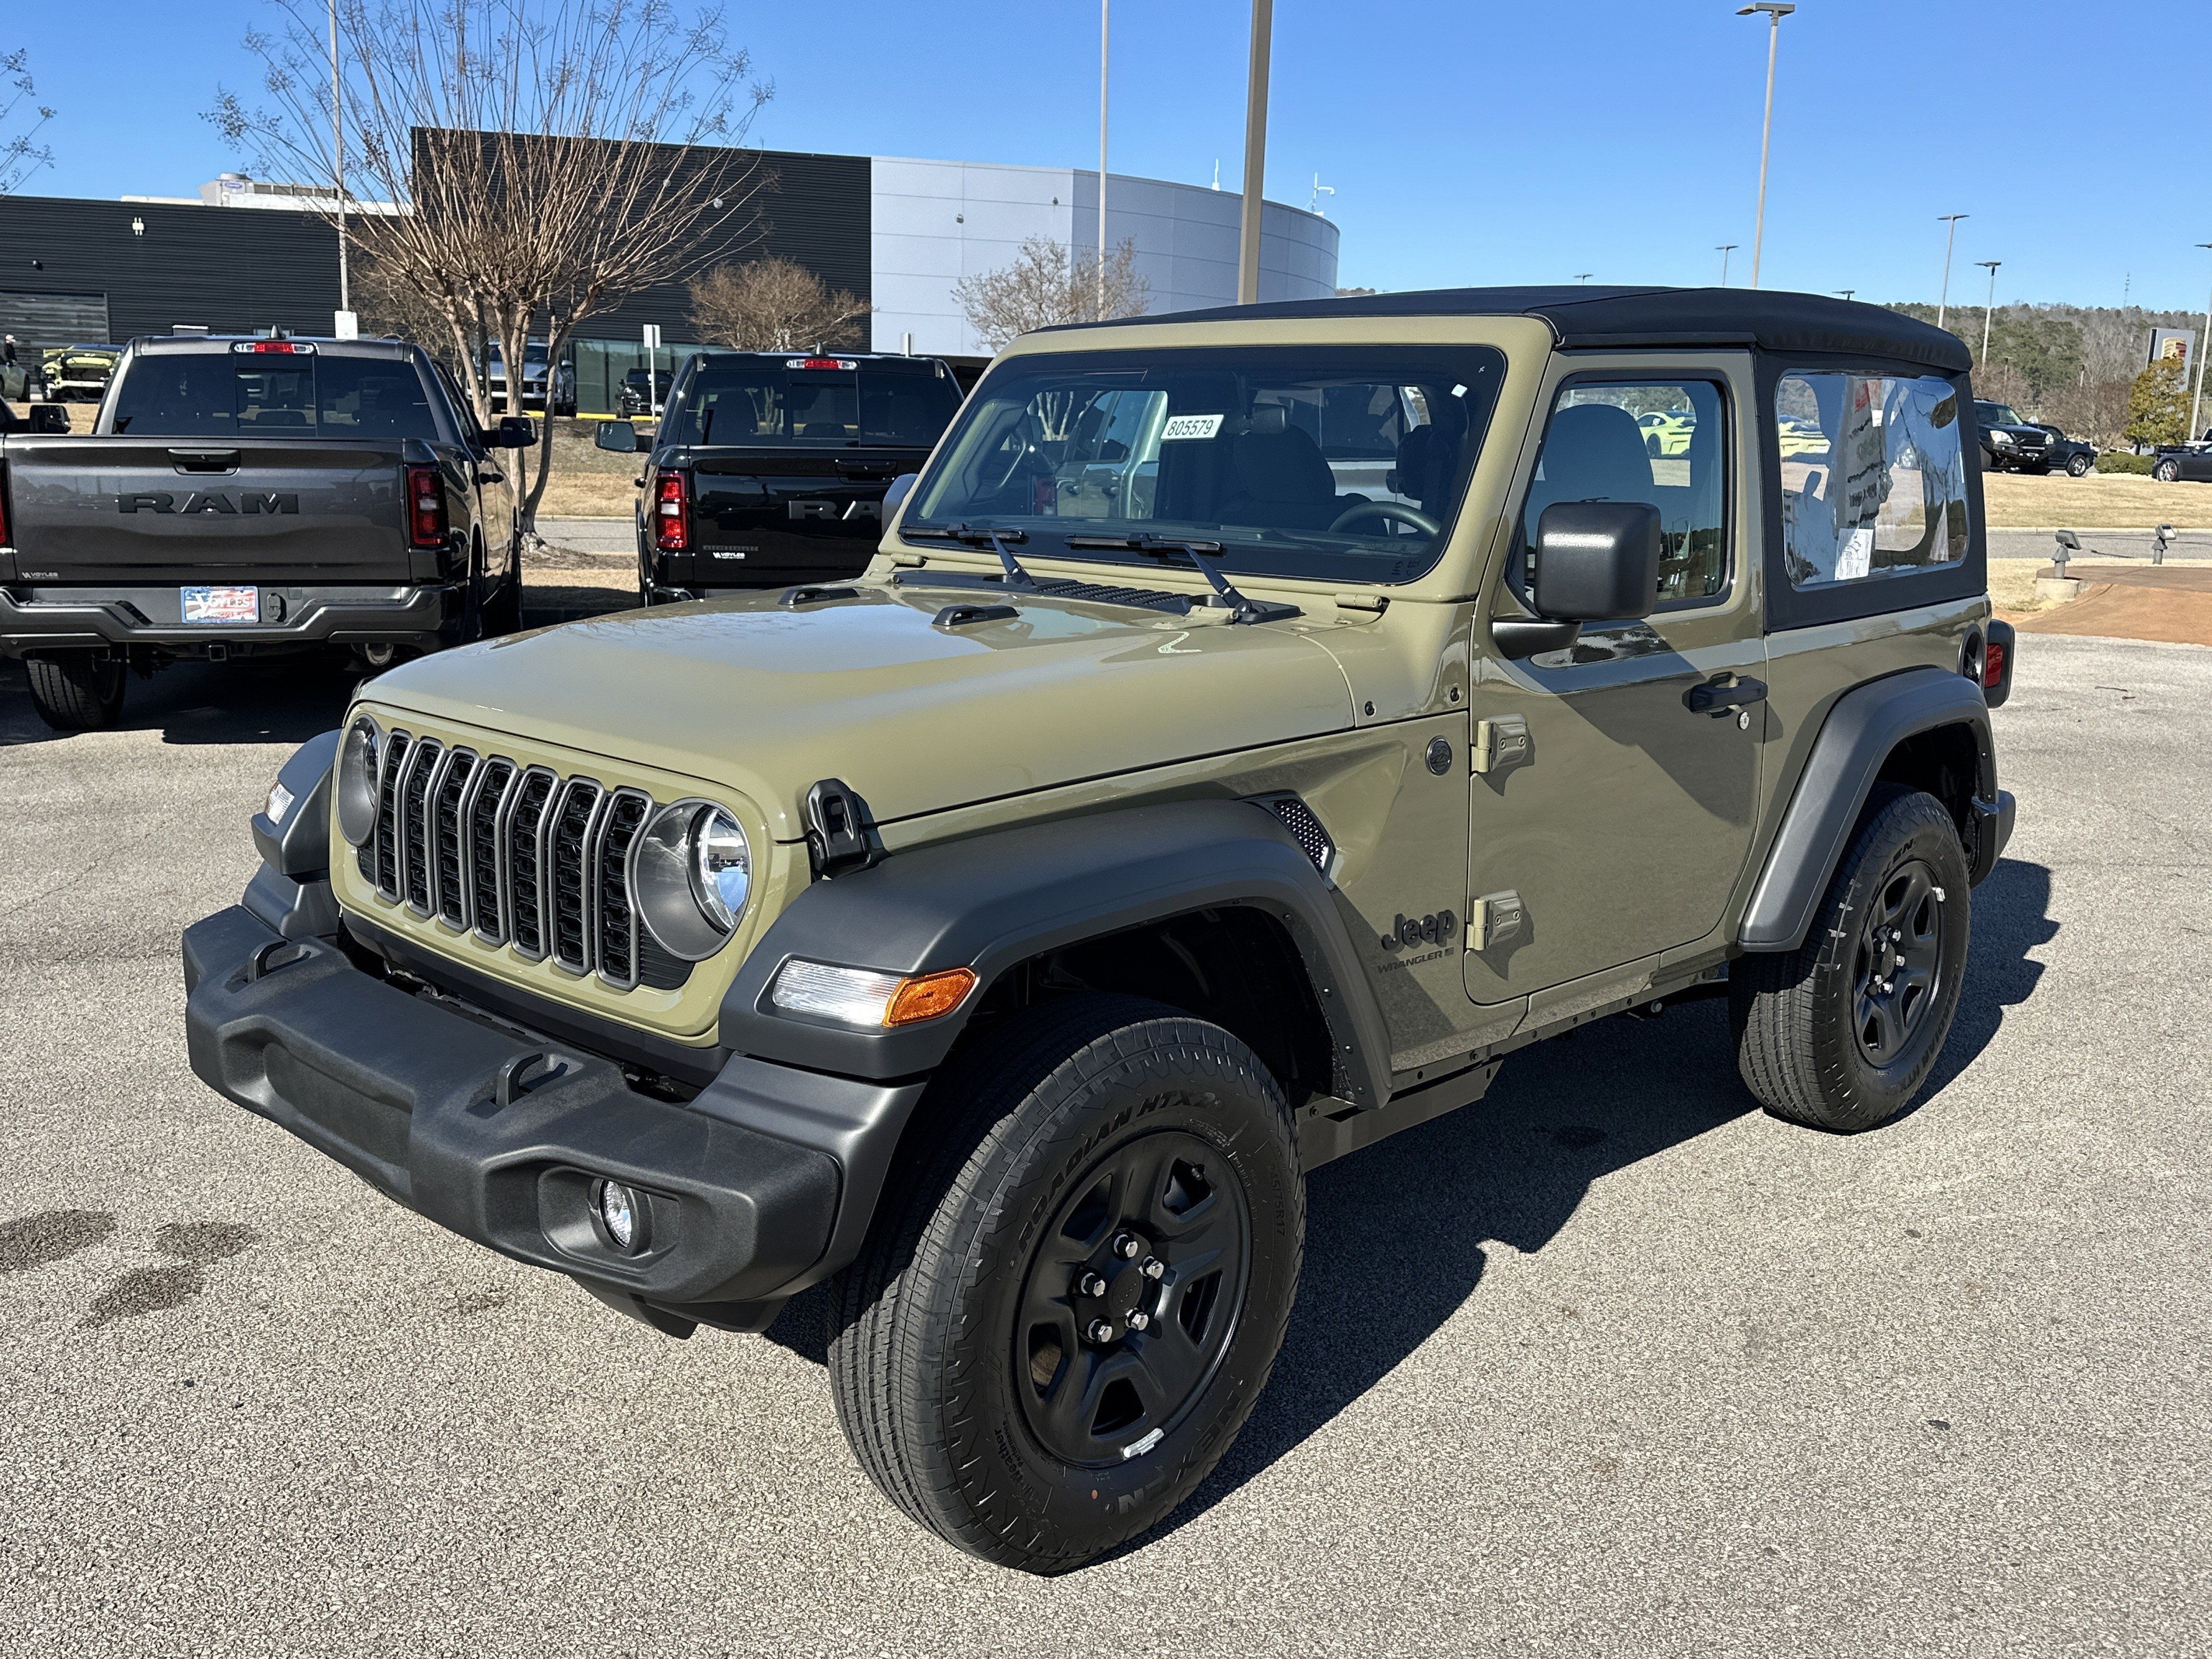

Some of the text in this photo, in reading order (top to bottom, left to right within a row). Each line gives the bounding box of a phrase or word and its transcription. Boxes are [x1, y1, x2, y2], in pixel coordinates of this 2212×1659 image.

[1167, 419, 1214, 436] 805579
[117, 493, 300, 514] RAM
[788, 500, 883, 520] RA
[1381, 909, 1457, 951] Jeep
[1377, 950, 1443, 974] WRANGLER
